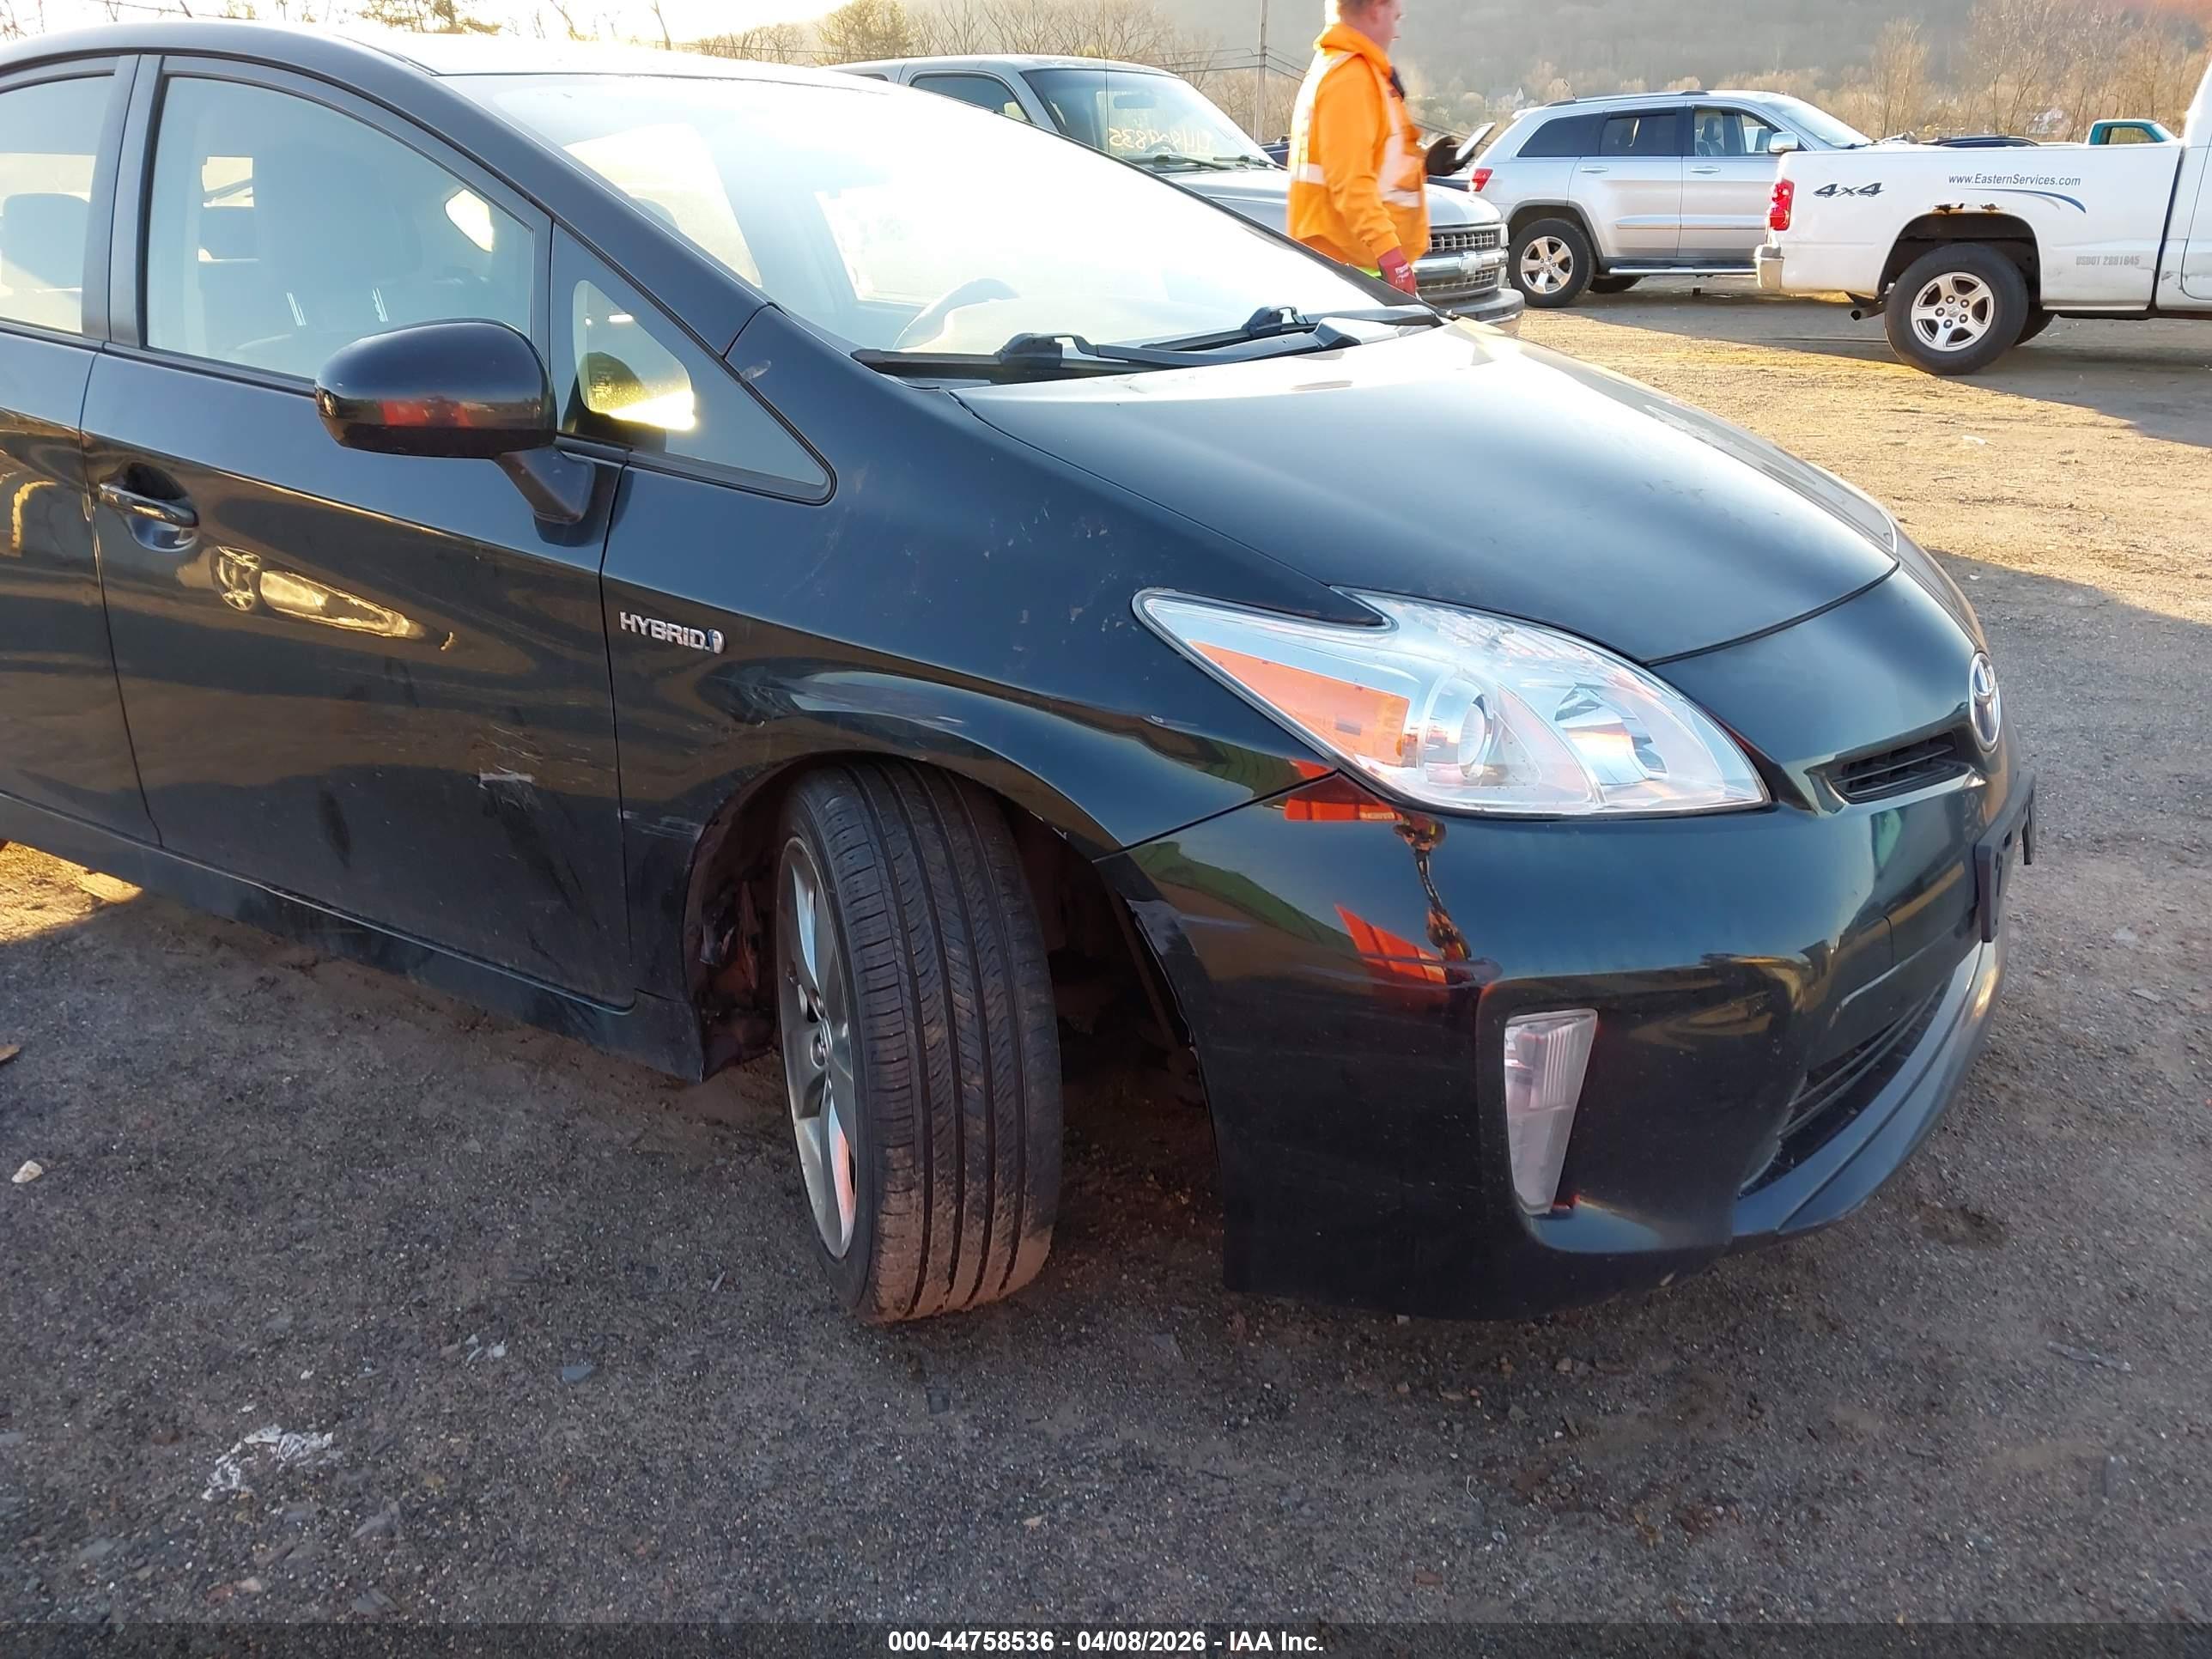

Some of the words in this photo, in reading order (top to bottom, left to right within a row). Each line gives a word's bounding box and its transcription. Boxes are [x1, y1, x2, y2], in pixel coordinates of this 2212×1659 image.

[1948, 173, 2081, 186] www.EasternServices.com
[1813, 182, 1885, 198] 4x4
[619, 611, 706, 650] HYBRID
